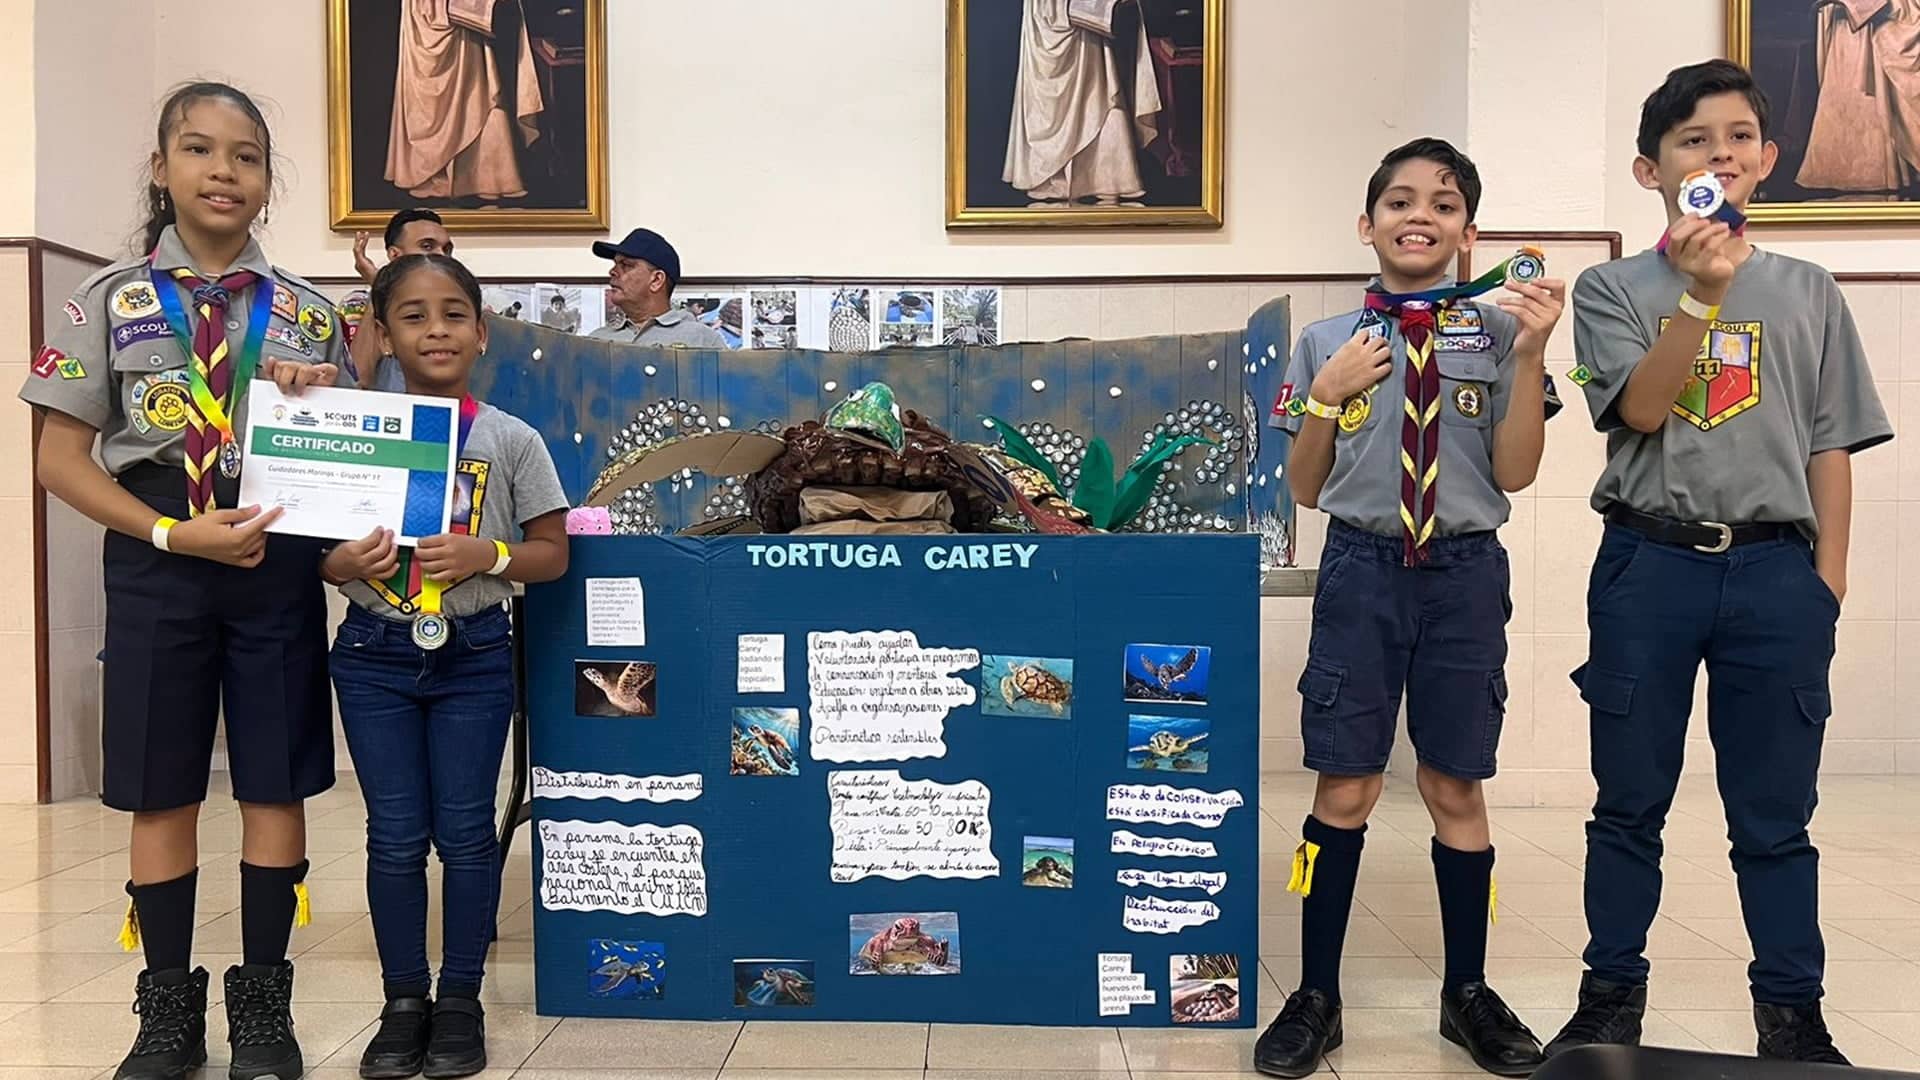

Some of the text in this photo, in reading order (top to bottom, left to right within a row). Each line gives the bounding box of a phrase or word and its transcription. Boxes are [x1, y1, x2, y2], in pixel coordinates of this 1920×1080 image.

[1714, 322, 1747, 332] SCOUT
[1699, 362, 1719, 376] 11
[324, 412, 358, 421] SCOUTS
[271, 434, 376, 455] CERTIFICADO
[747, 543, 1038, 570] TORTUGA CAREY
[624, 779, 643, 789] en
[540, 825, 560, 841] En
[626, 832, 644, 846] la
[1113, 836, 1126, 846] En
[546, 849, 587, 863] carey
[587, 849, 606, 862] se
[680, 851, 701, 864] en
[631, 862, 646, 878] el
[1200, 903, 1215, 918] del
